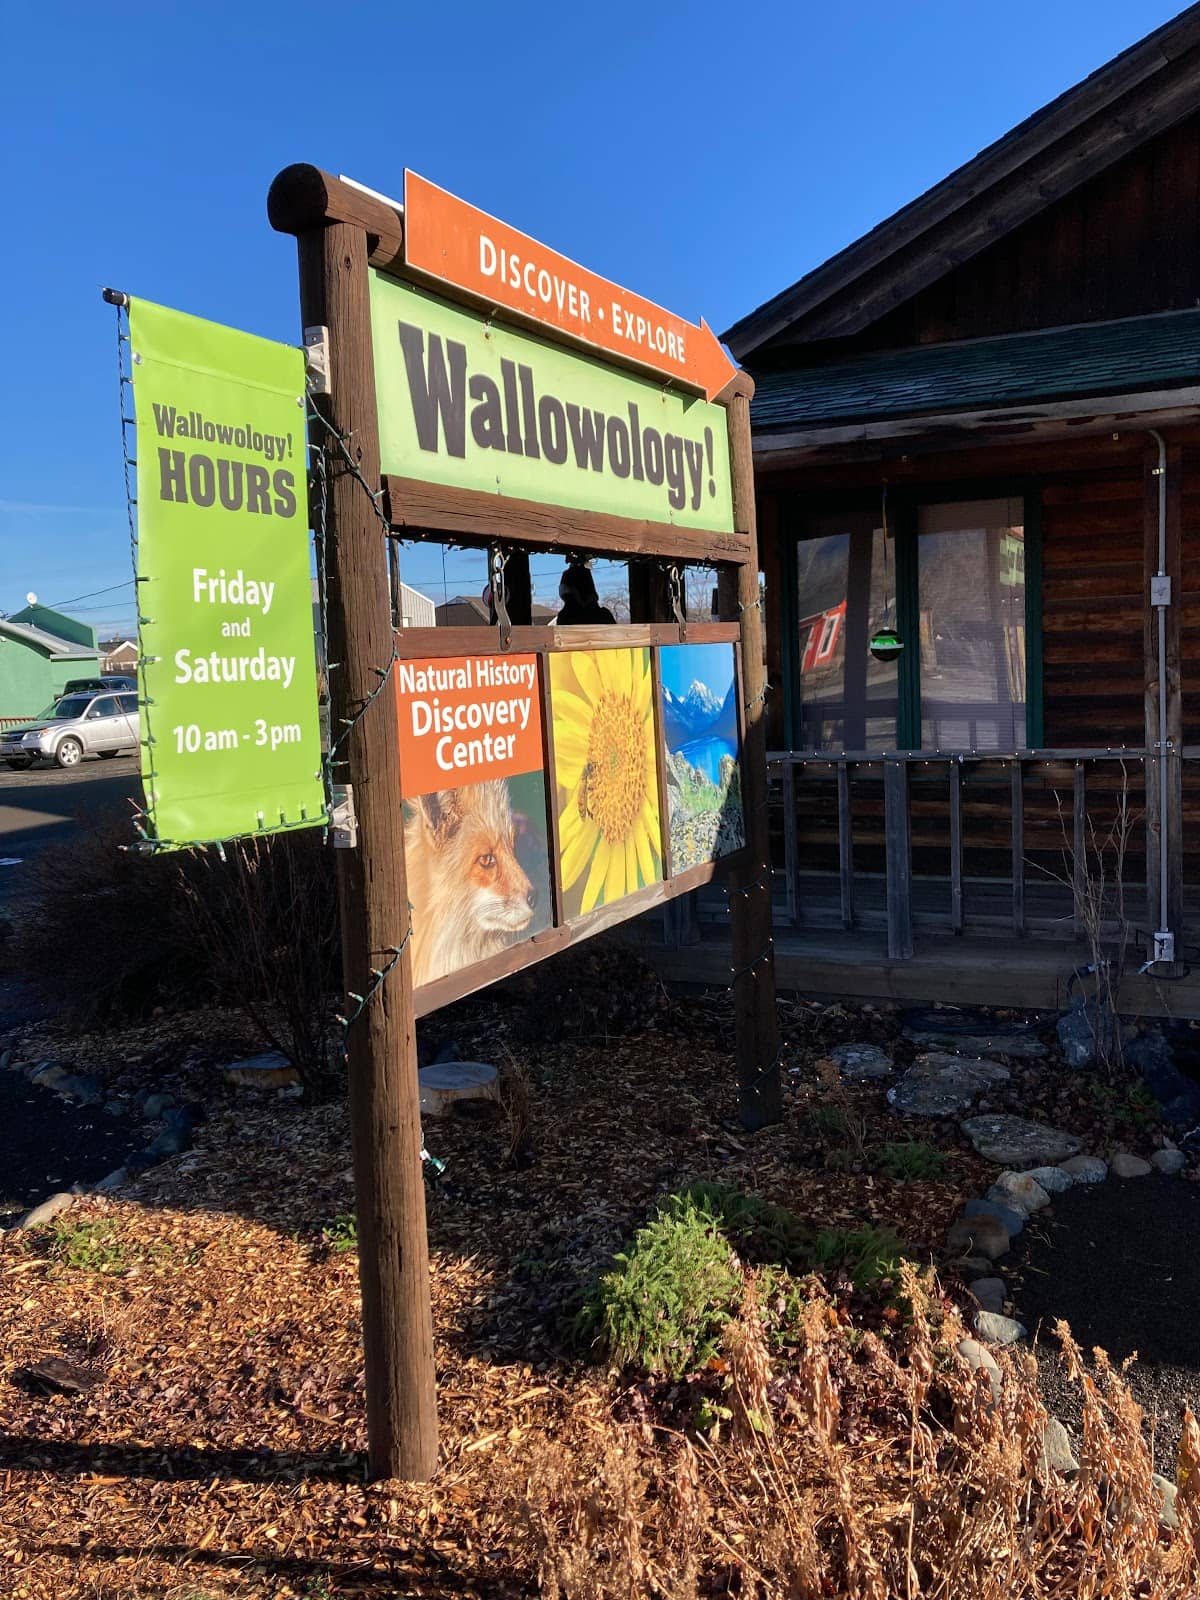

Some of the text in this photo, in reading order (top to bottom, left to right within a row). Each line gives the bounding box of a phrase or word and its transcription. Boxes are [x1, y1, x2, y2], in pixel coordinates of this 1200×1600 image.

[479, 235, 686, 364] DISCOVER EXPLORE
[152, 402, 293, 462] Wallowology!
[398, 319, 717, 512] Wallowology!
[157, 447, 297, 518] HOURS
[192, 568, 275, 614] Friday
[221, 617, 251, 637] and
[174, 647, 296, 688] Saturday
[399, 660, 536, 694] Natural History
[411, 697, 531, 737] Discovery
[435, 733, 516, 771] Center
